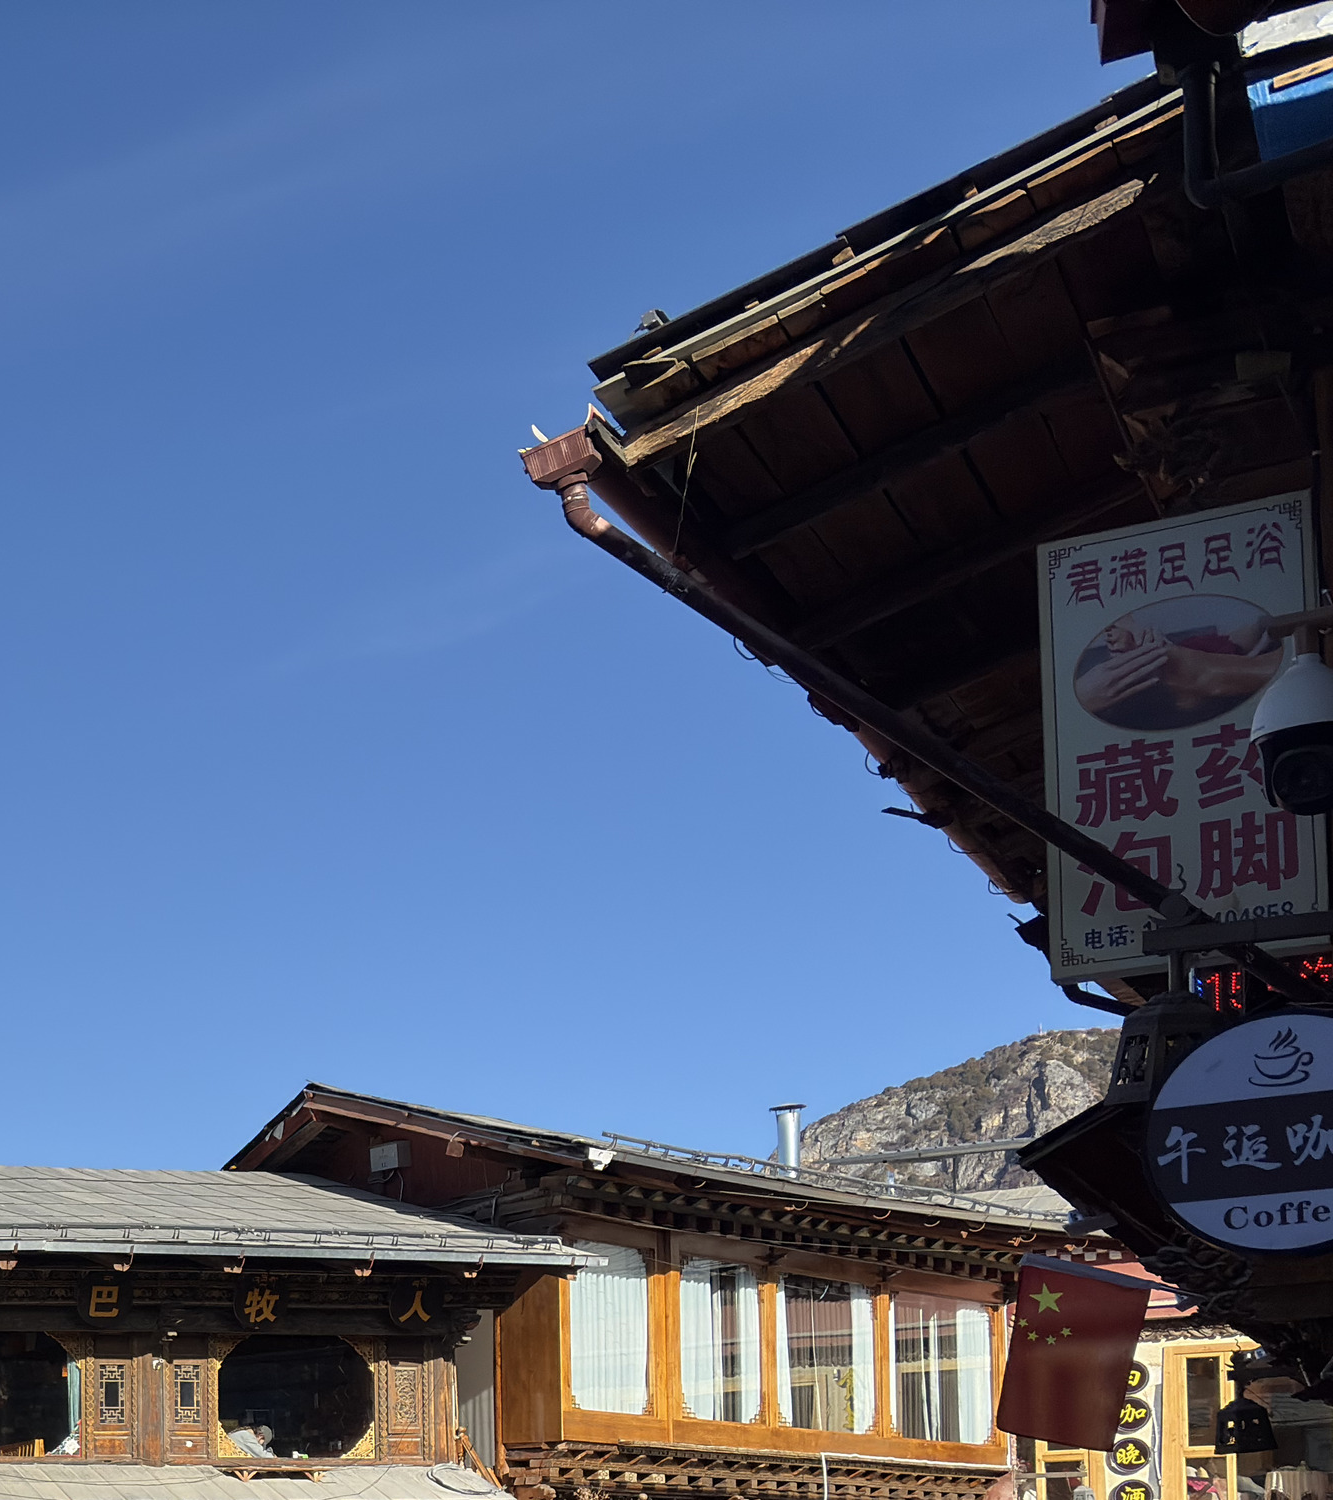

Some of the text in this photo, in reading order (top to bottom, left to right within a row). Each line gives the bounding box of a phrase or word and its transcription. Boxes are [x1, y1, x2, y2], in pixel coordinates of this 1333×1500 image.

[1066, 521, 1287, 608] 君满足足浴
[1076, 810, 1300, 917] 泡脚
[89, 1286, 119, 1318] 巴
[244, 1288, 279, 1323] 牧
[398, 1290, 431, 1323] 人
